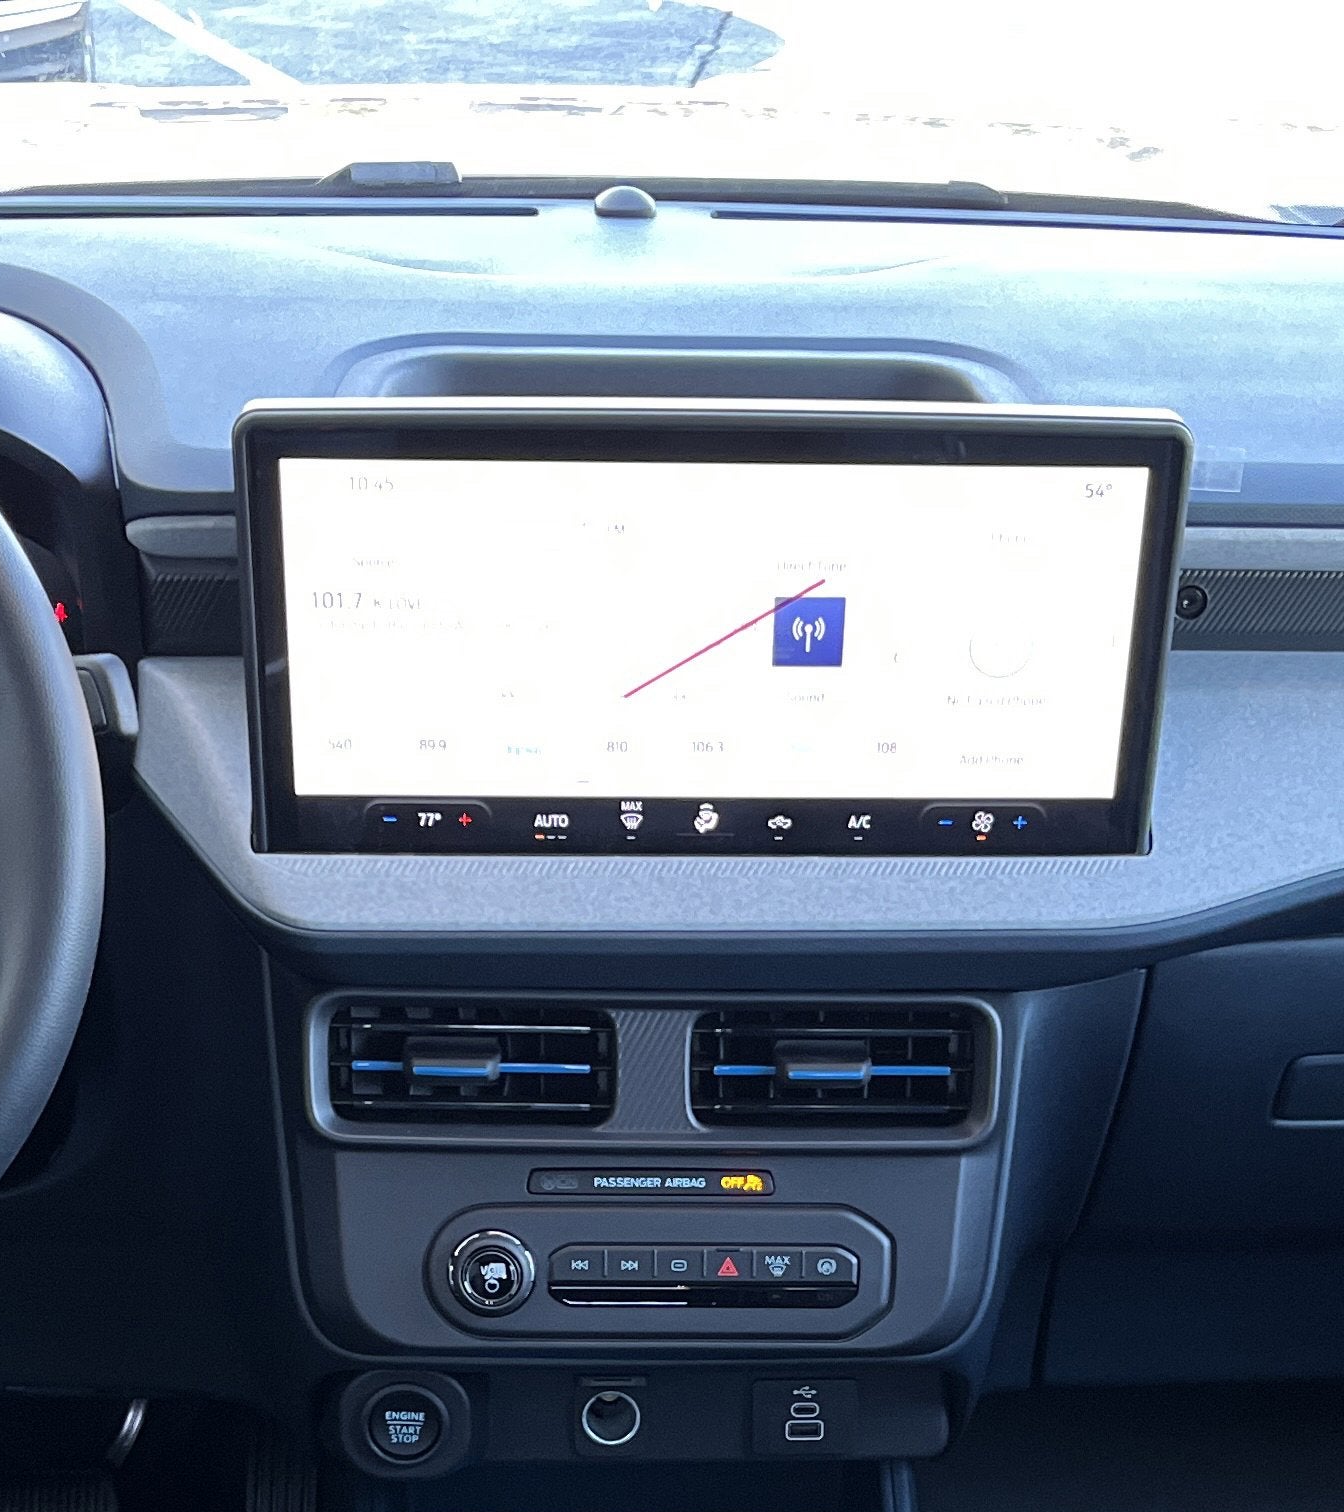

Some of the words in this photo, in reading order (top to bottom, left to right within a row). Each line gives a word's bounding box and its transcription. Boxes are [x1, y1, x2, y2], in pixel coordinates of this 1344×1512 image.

[349, 476, 394, 491] 1045
[419, 739, 447, 750] 899
[692, 741, 724, 752] 1063
[620, 800, 643, 811] MAX
[533, 814, 569, 828] AUTO
[847, 814, 871, 829] A/C
[593, 1177, 662, 1188] PASSENGER
[664, 1177, 706, 1188] AIRBAG
[720, 1176, 745, 1189] OFF
[764, 1255, 791, 1265] MAX
[385, 1410, 426, 1421] ENGINE
[388, 1425, 422, 1435] START
[390, 1434, 420, 1443] STOP
